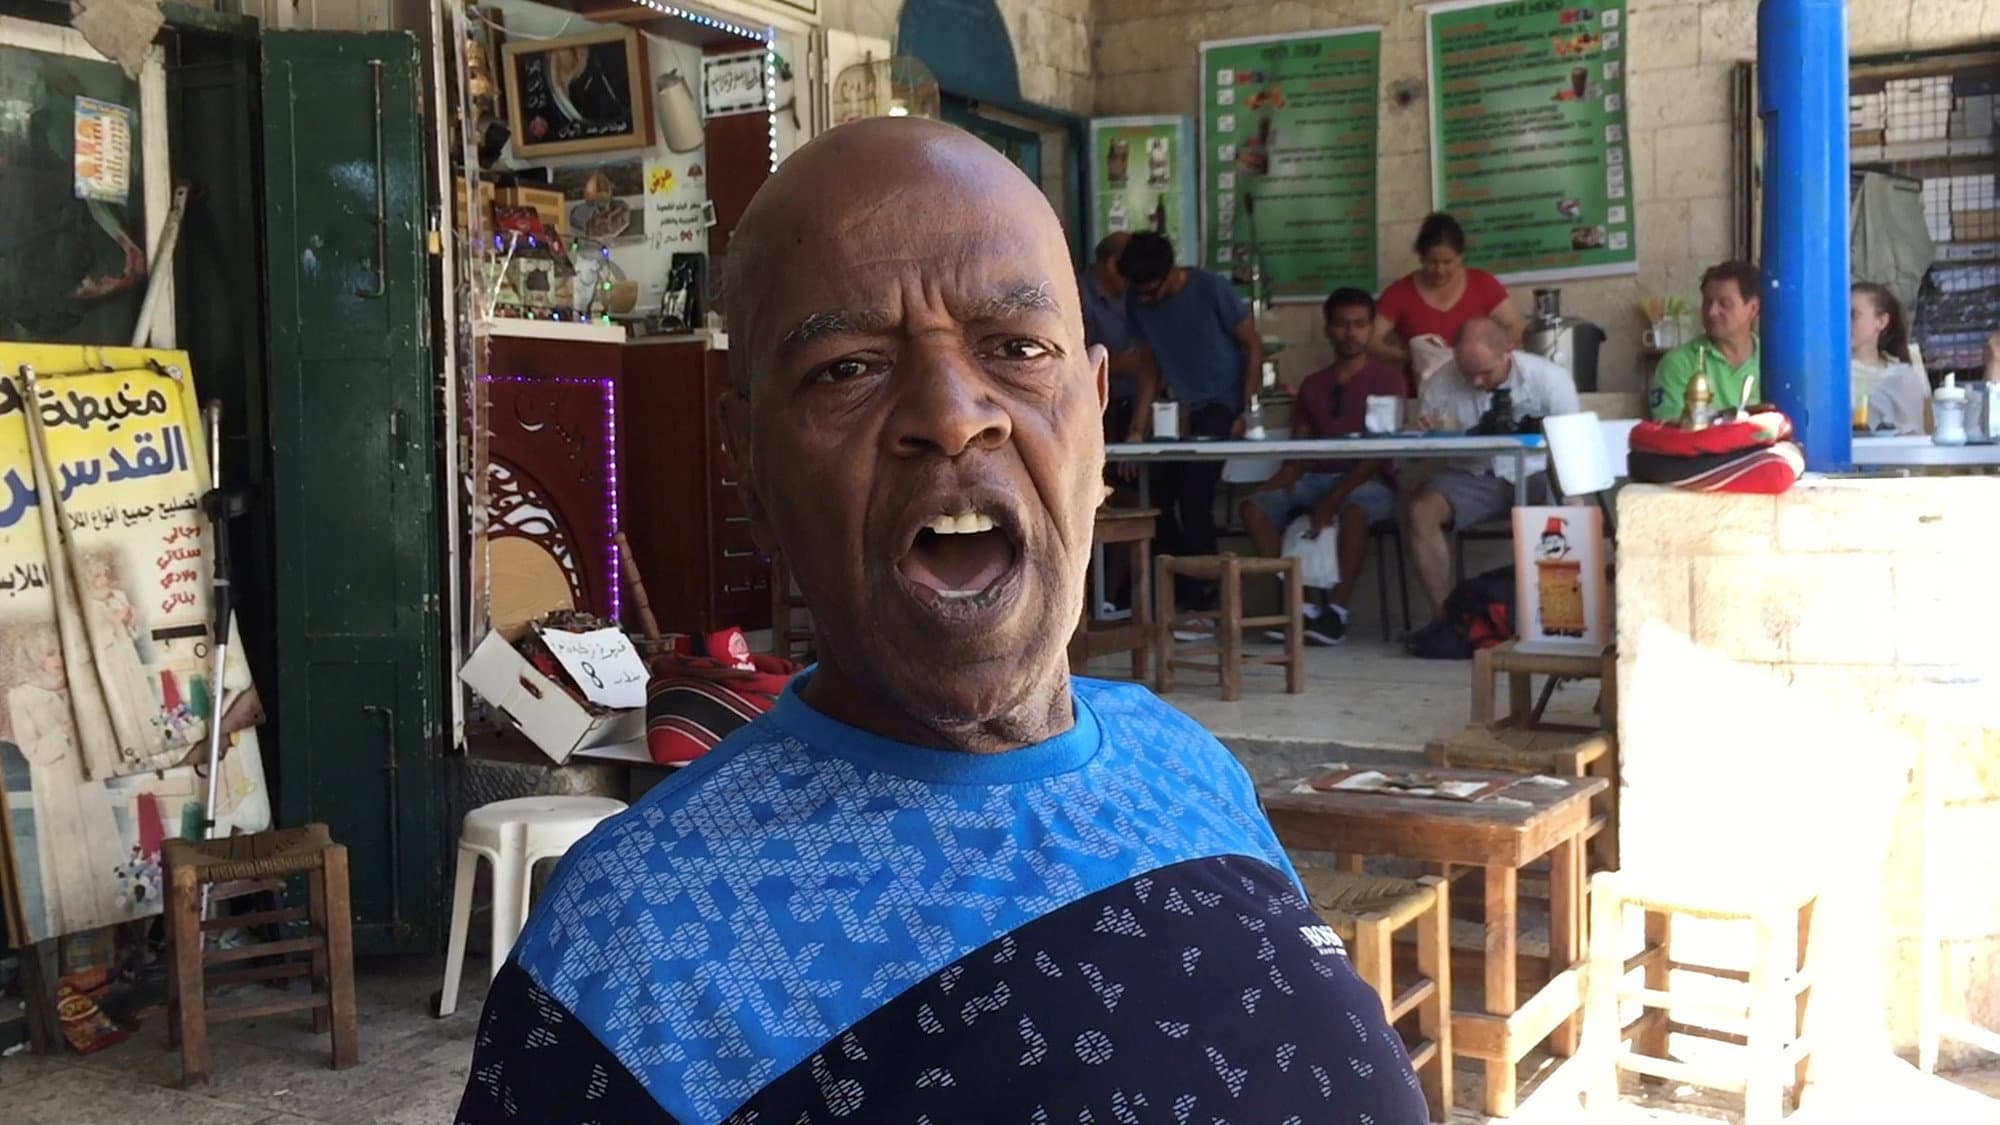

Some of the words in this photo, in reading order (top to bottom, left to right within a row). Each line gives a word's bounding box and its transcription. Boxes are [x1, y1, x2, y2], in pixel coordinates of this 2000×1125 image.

[58, 425, 188, 502] القدس
[67, 511, 89, 530] الملا
[122, 505, 154, 527] جميع
[0, 563, 49, 598] الملاب
